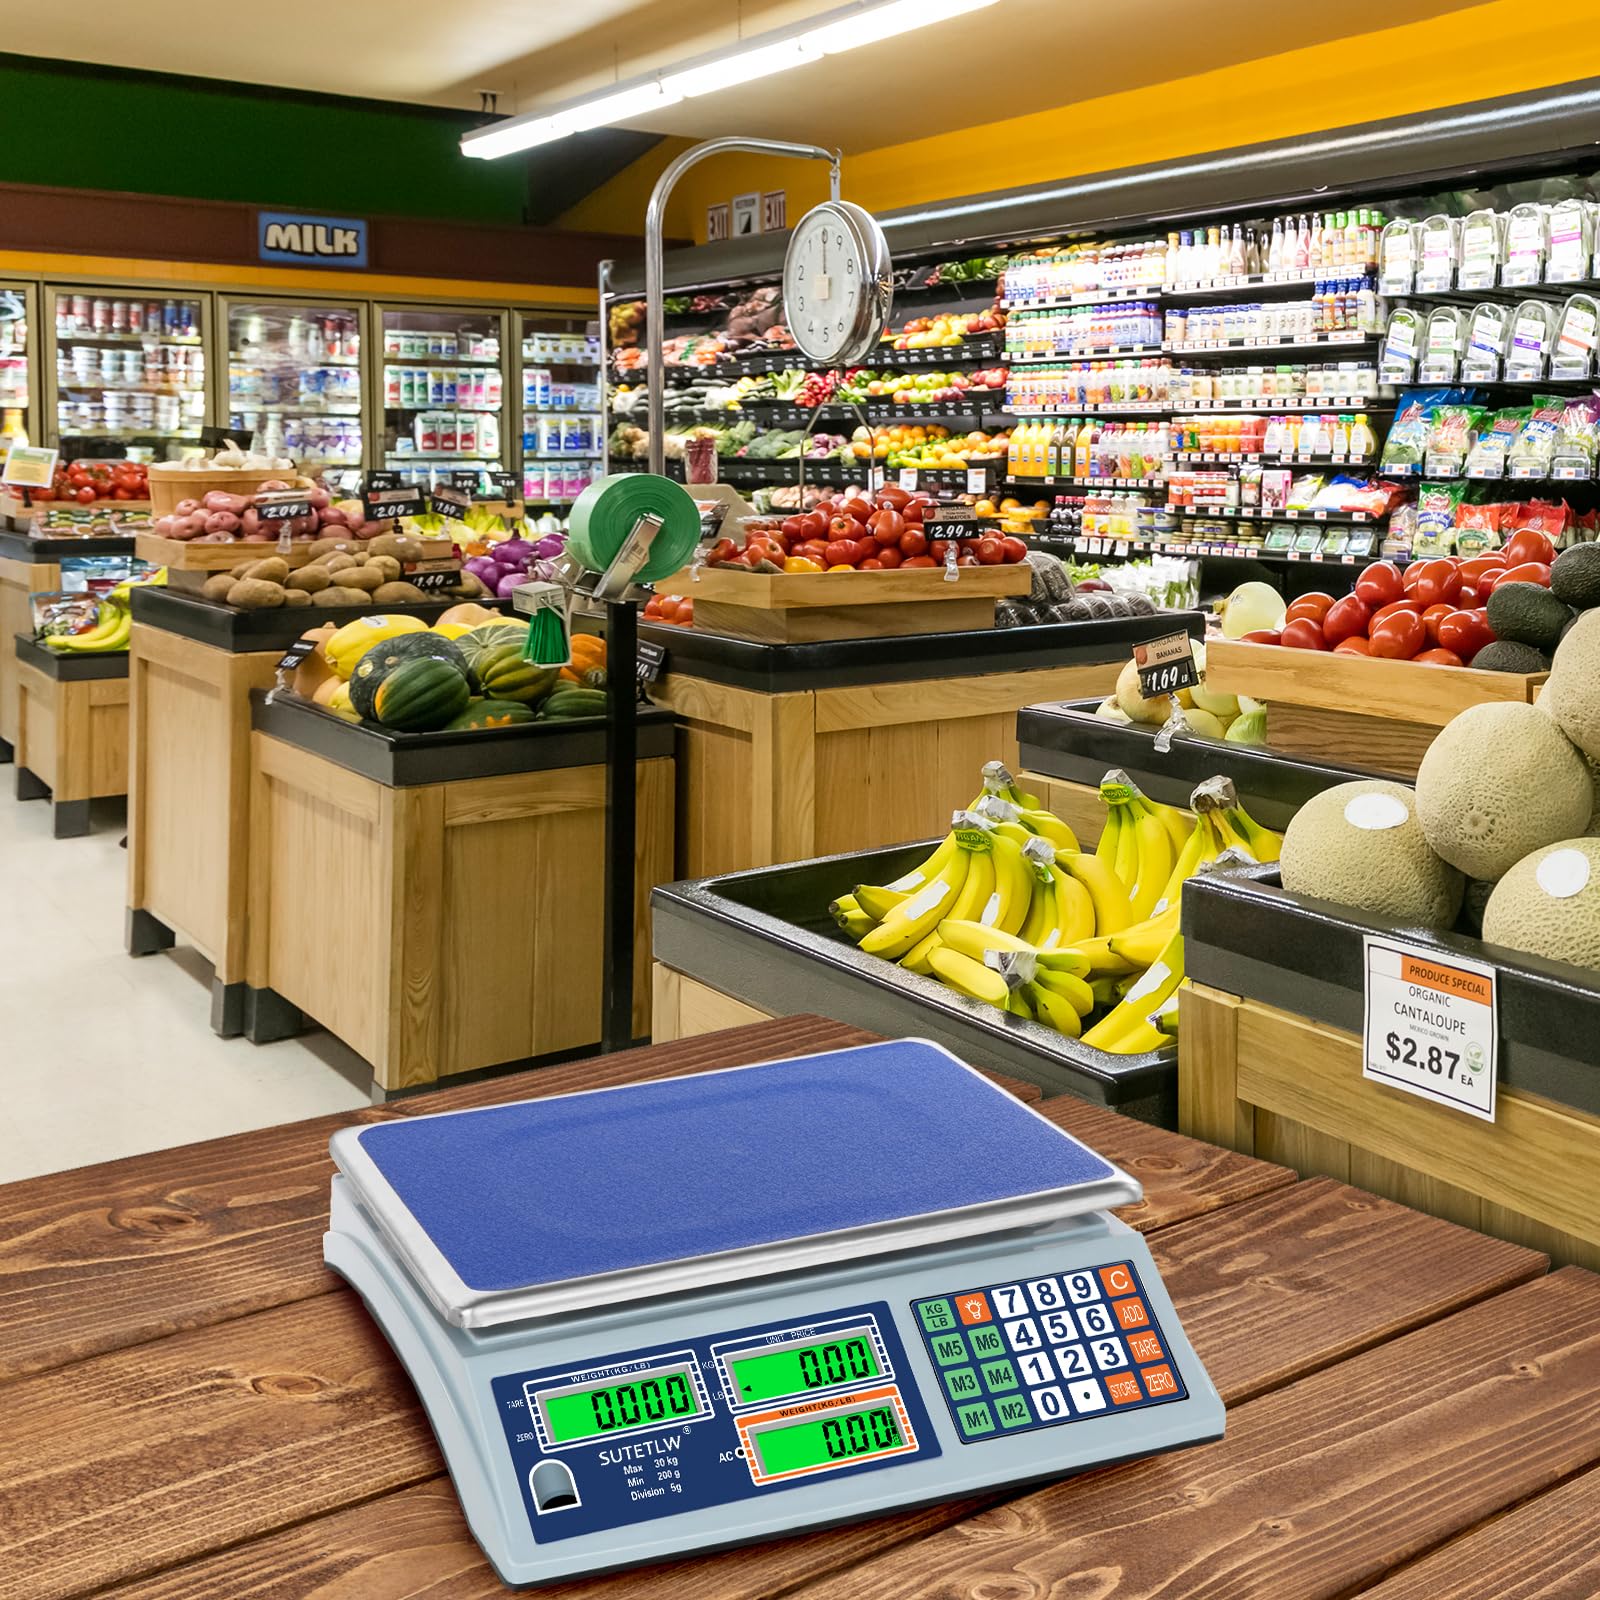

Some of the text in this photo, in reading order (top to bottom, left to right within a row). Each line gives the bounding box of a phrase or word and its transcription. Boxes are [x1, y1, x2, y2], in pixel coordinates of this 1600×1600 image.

[264, 223, 360, 256] MILK
[808, 240, 812, 251] 1
[836, 235, 842, 251] 9
[798, 265, 804, 281] 2
[847, 259, 853, 275] 8
[798, 297, 804, 312] 3
[848, 291, 854, 307] 7
[808, 321, 814, 335] 4
[823, 327, 828, 343] 5
[838, 318, 844, 333] 6
[1156, 646, 1183, 660] BANANAS
[1147, 666, 1178, 692] $1.69
[1409, 965, 1485, 996] PRODUCE SPECIAL
[1409, 985, 1451, 1007] ORGANIC
[1394, 1002, 1466, 1035] CANTALOUPE
[1386, 1032, 1460, 1080] $2.87
[1461, 1074, 1474, 1087] EA
[1072, 1275, 1091, 1299] 9
[1110, 1271, 1129, 1290] C
[1000, 1289, 1016, 1313] 7
[1036, 1282, 1057, 1307] 8
[925, 1304, 943, 1315] KG
[1122, 1304, 1144, 1324] ADD
[932, 1317, 948, 1328] LB
[1048, 1314, 1068, 1339] 5
[1085, 1308, 1105, 1332] 6
[765, 1327, 816, 1345] UNIT PRICE
[975, 1332, 1000, 1351] M6
[1015, 1322, 1034, 1346] 4
[938, 1340, 963, 1358] M5
[1100, 1342, 1120, 1366] 3
[1131, 1337, 1160, 1358] TARE
[702, 1360, 714, 1370] KG
[798, 1339, 870, 1388] 0.00
[1028, 1357, 1045, 1381] 1
[1063, 1349, 1084, 1374] 2
[951, 1375, 976, 1393] M3
[987, 1367, 1012, 1385] M4
[1145, 1371, 1175, 1392] ZERO
[712, 1390, 725, 1402] LB
[1110, 1380, 1140, 1399] STORE
[506, 1398, 525, 1410] TARE
[590, 1374, 690, 1430] 0.000
[1001, 1402, 1026, 1420] M2
[1041, 1391, 1060, 1416] 0
[965, 1411, 990, 1428] M1
[516, 1431, 534, 1443] ZERO
[623, 1455, 678, 1476] Max 30 kg
[718, 1450, 735, 1464] AC
[627, 1469, 681, 1488] Min 200 g
[630, 1482, 683, 1502] Division 5g
